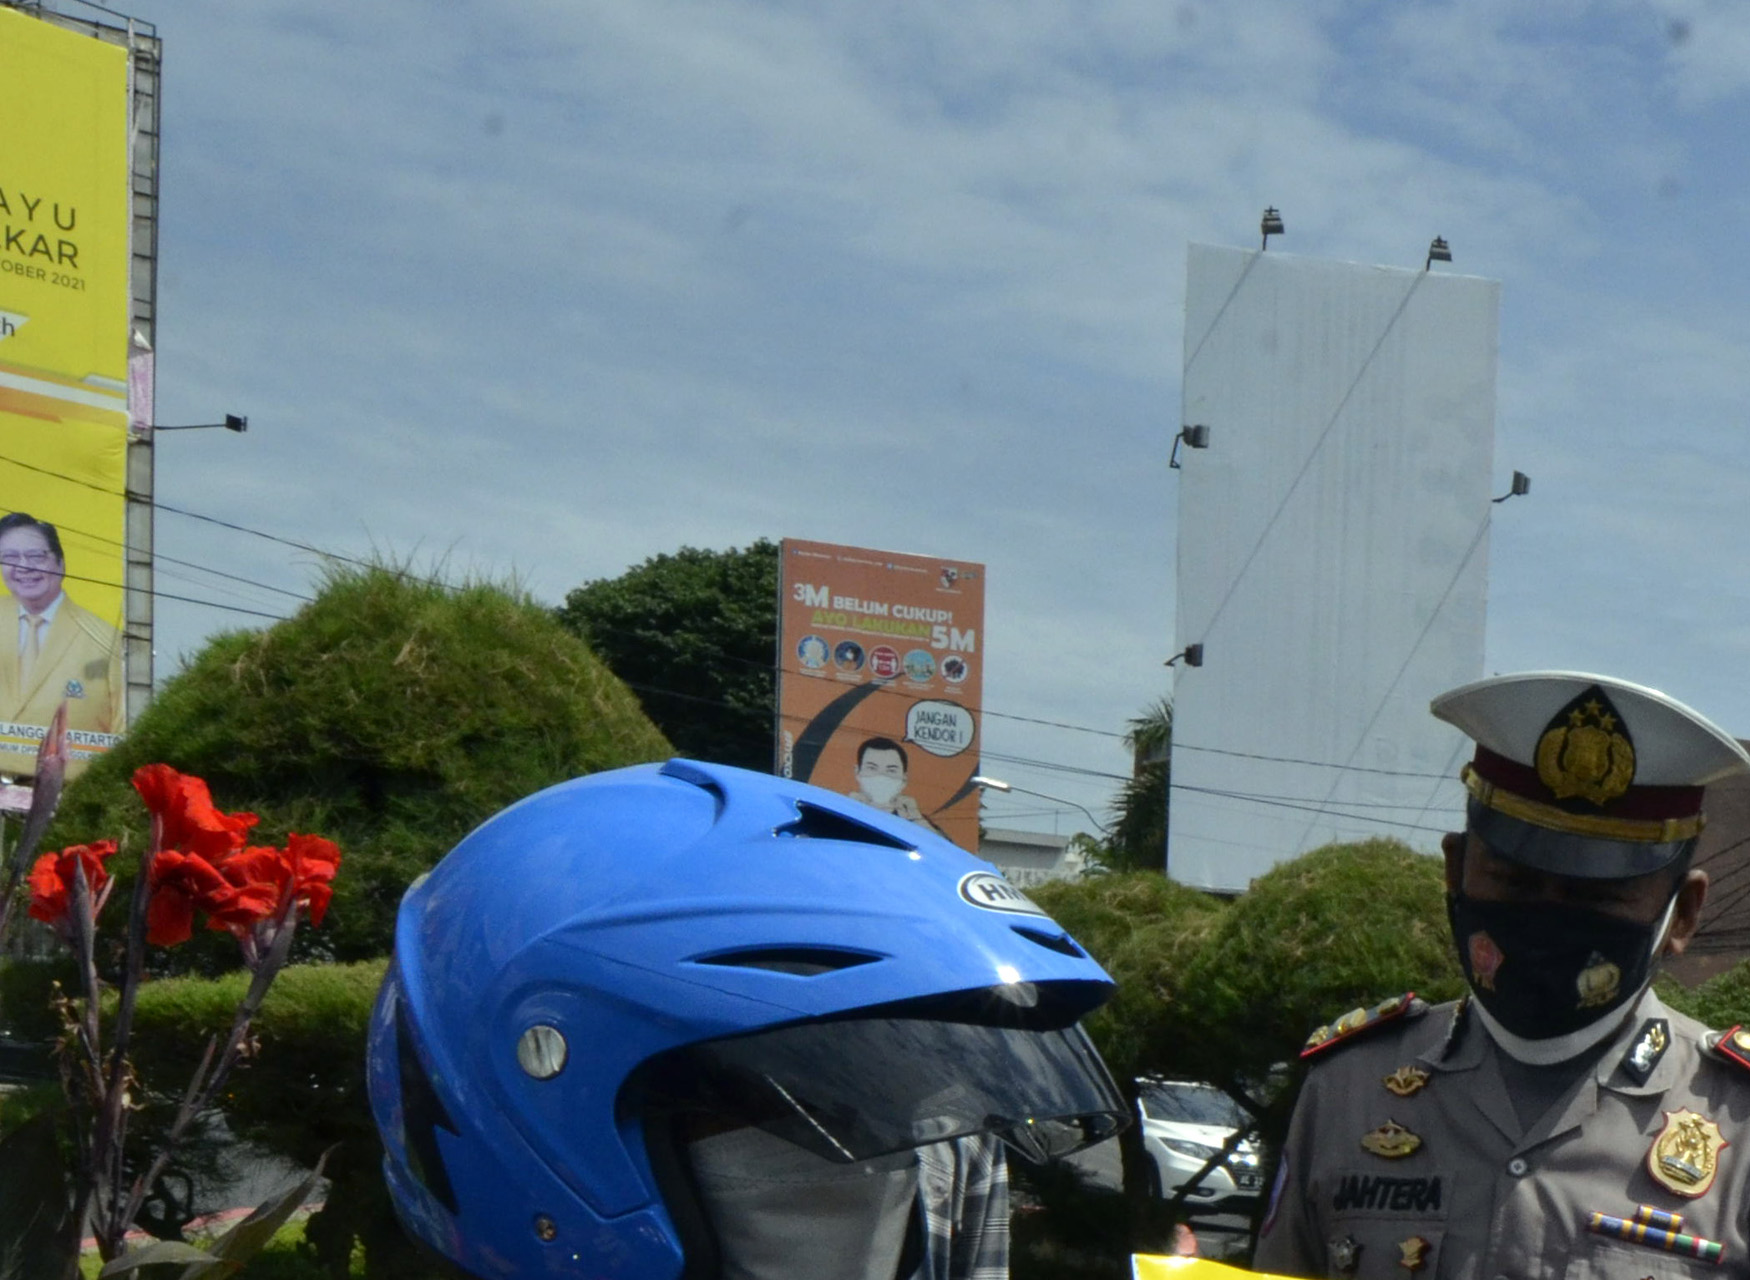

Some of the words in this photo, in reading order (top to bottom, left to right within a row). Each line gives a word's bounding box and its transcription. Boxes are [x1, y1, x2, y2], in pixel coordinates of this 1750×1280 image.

[0, 224, 78, 269] KAR
[51, 272, 86, 292] 2021
[793, 583, 829, 608] 3M
[833, 595, 889, 617] BELUM
[892, 604, 953, 624] CUKUP!
[811, 610, 848, 626] AYO
[852, 614, 931, 637] LAKUKAN
[931, 625, 976, 653] 5M
[914, 711, 957, 727] JANGAN
[0, 725, 46, 740] LANGG
[64, 731, 122, 747] ARTARTO
[914, 726, 957, 742] KENDOR
